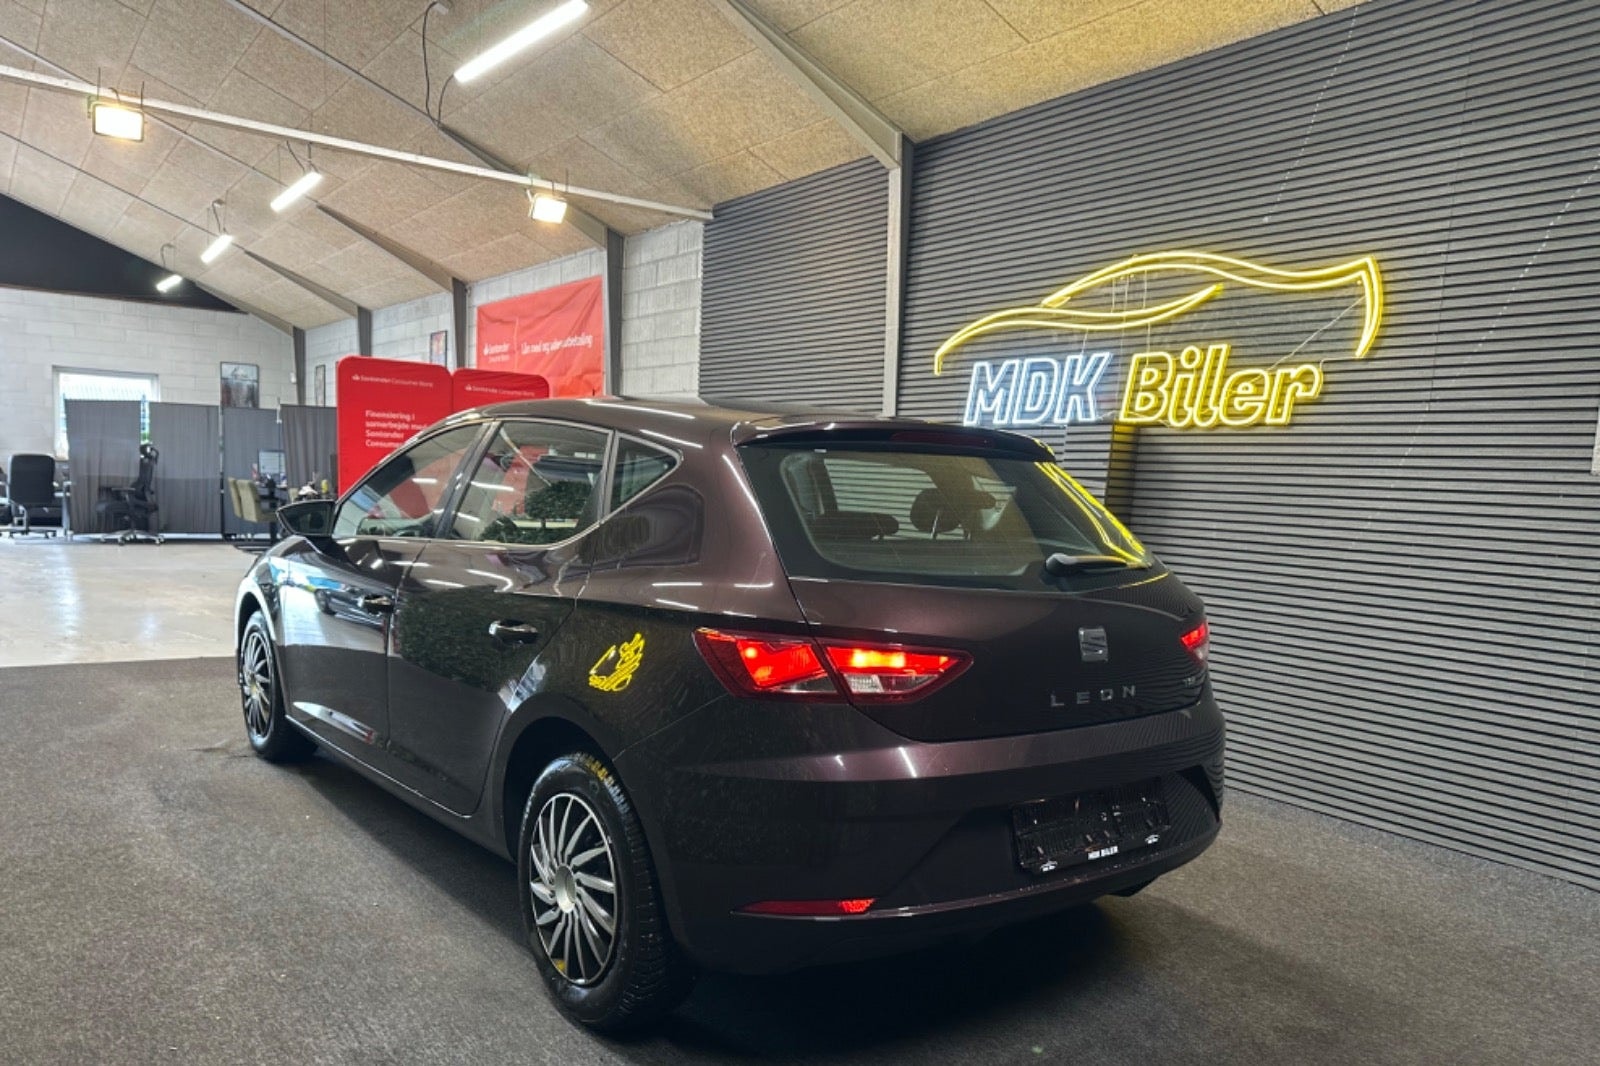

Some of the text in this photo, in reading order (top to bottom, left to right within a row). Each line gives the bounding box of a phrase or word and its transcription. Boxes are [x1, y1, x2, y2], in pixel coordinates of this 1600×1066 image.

[963, 343, 1322, 427] MDK Biler
[365, 429, 405, 439] Santander
[1050, 685, 1136, 707] LEON
